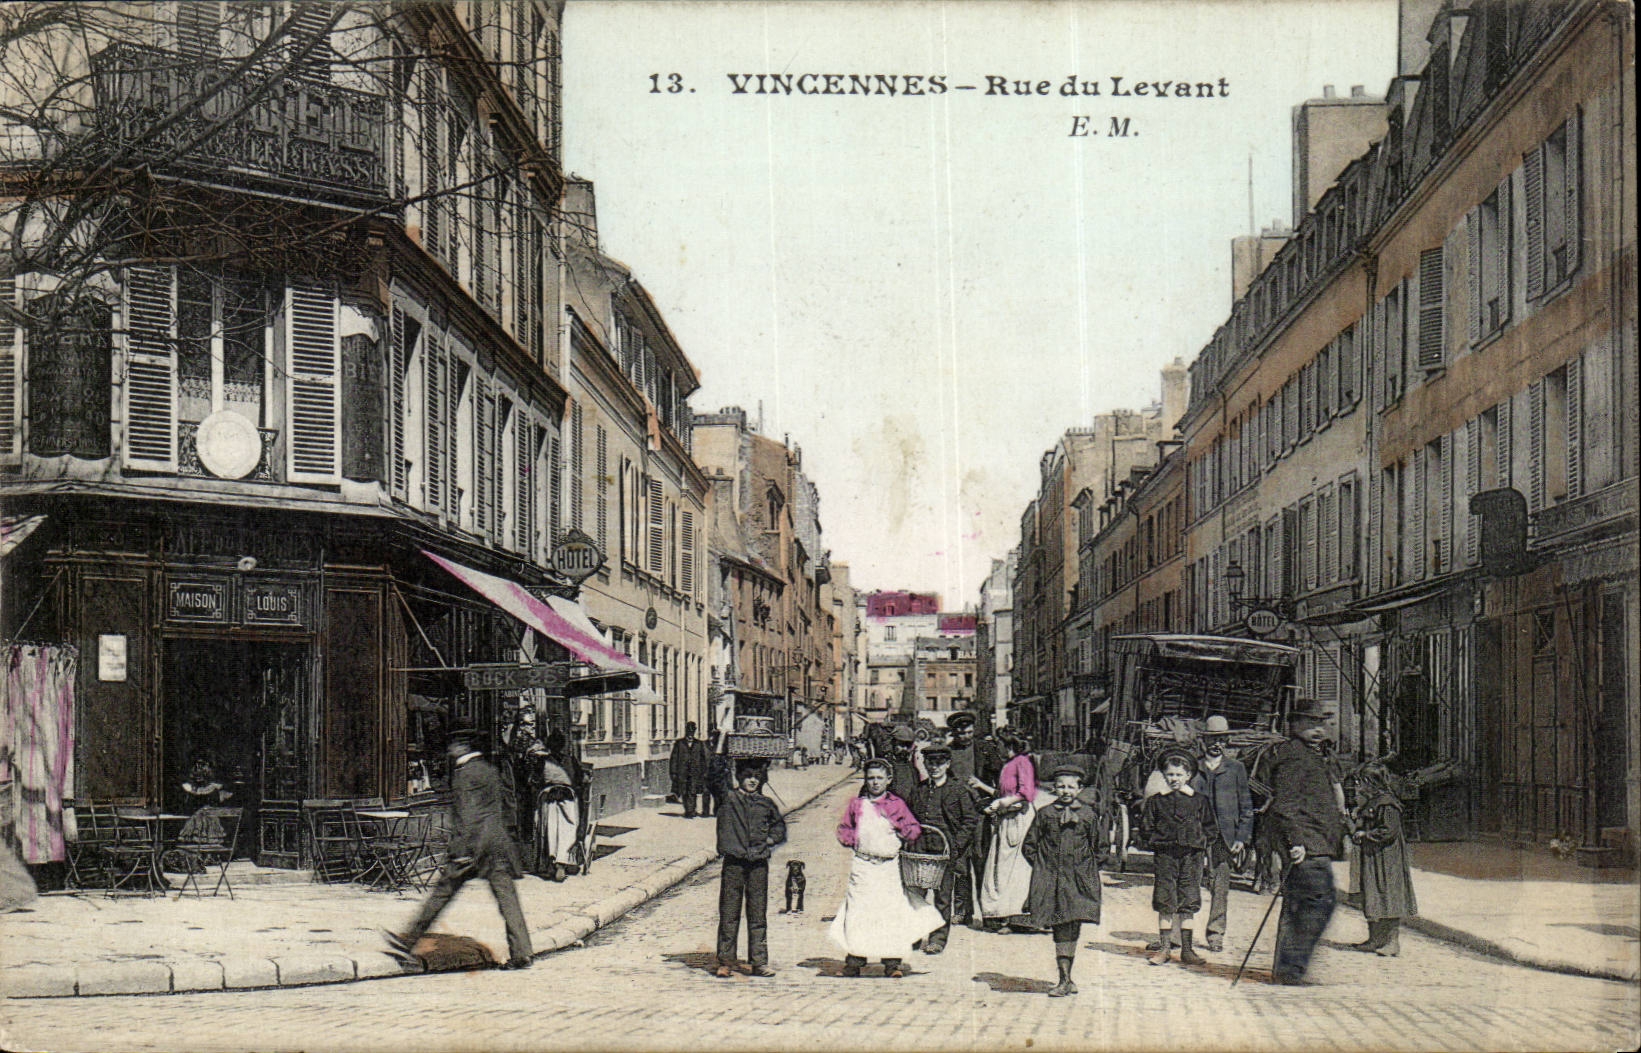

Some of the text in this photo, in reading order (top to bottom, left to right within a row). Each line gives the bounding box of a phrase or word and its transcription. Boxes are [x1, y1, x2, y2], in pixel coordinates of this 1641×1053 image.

[176, 592, 287, 612] MAISON LOUIS
[471, 671, 517, 687] BOCK
